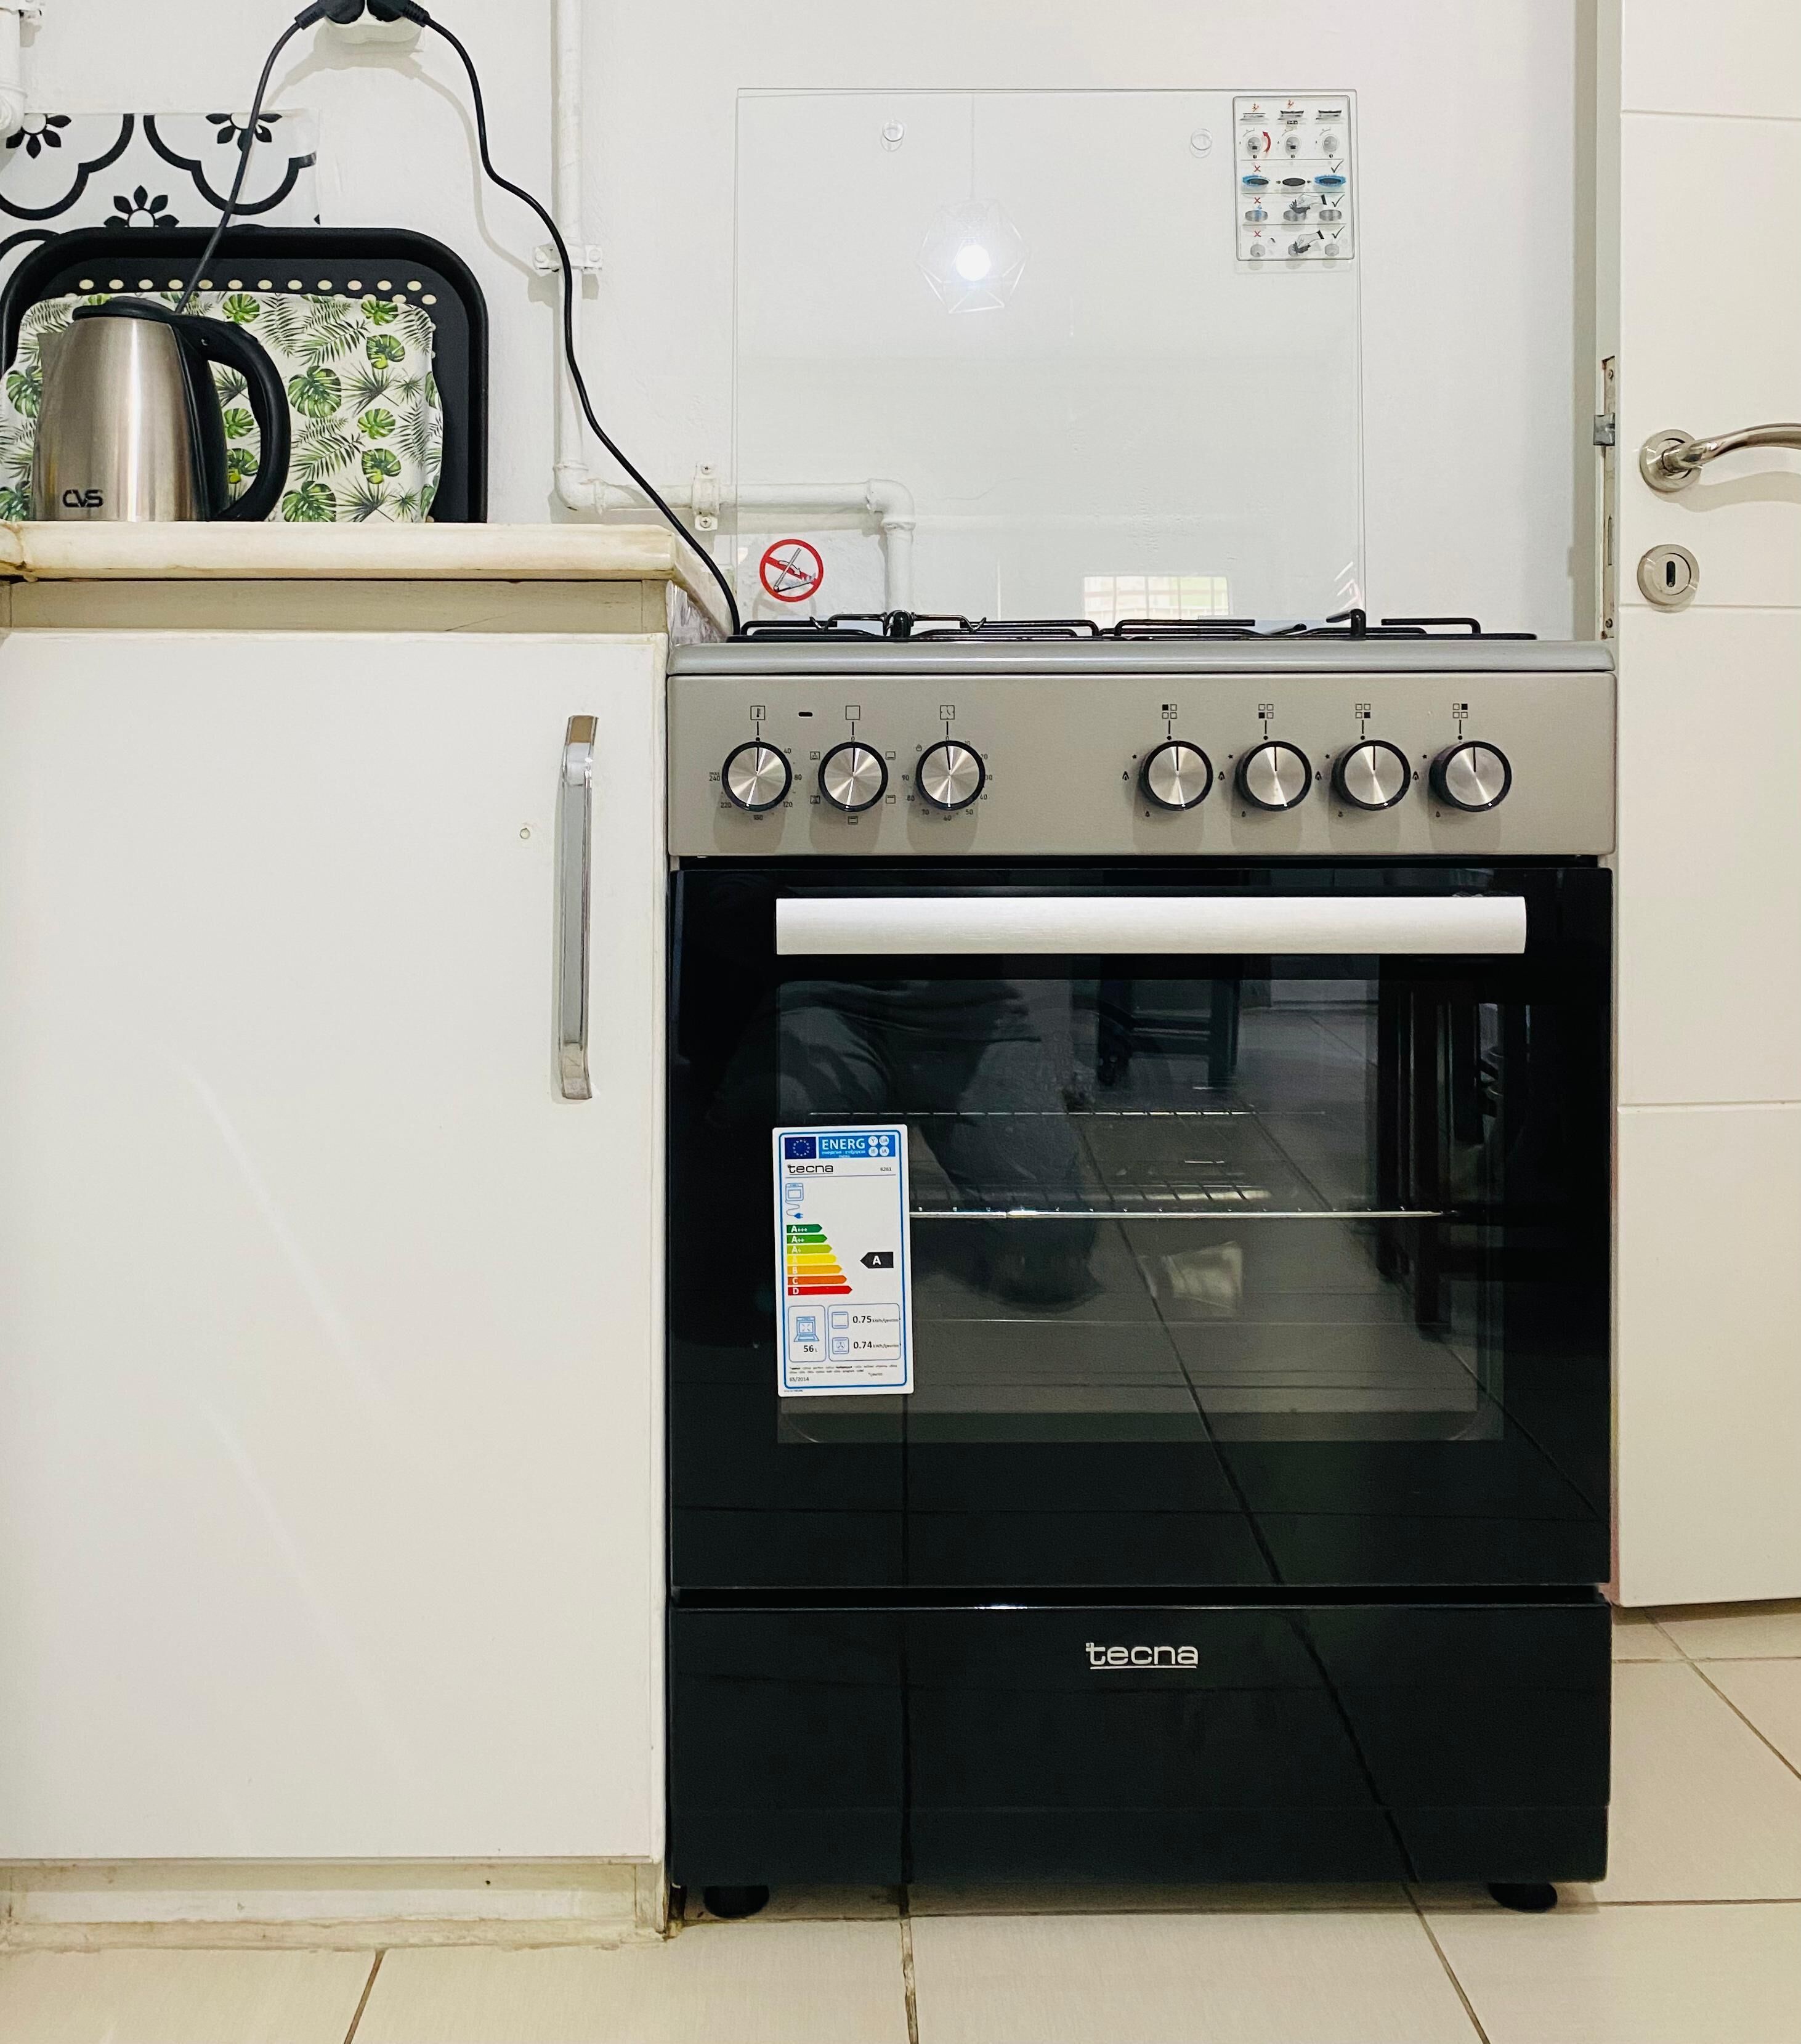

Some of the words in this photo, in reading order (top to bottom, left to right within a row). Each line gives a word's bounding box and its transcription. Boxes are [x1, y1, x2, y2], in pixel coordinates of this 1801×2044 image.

[63, 489, 104, 508] CVS
[822, 1138, 865, 1150] ENERG
[788, 1164, 833, 1174] tecna
[873, 1255, 881, 1265] A
[1085, 1642, 1199, 1666] tecna
